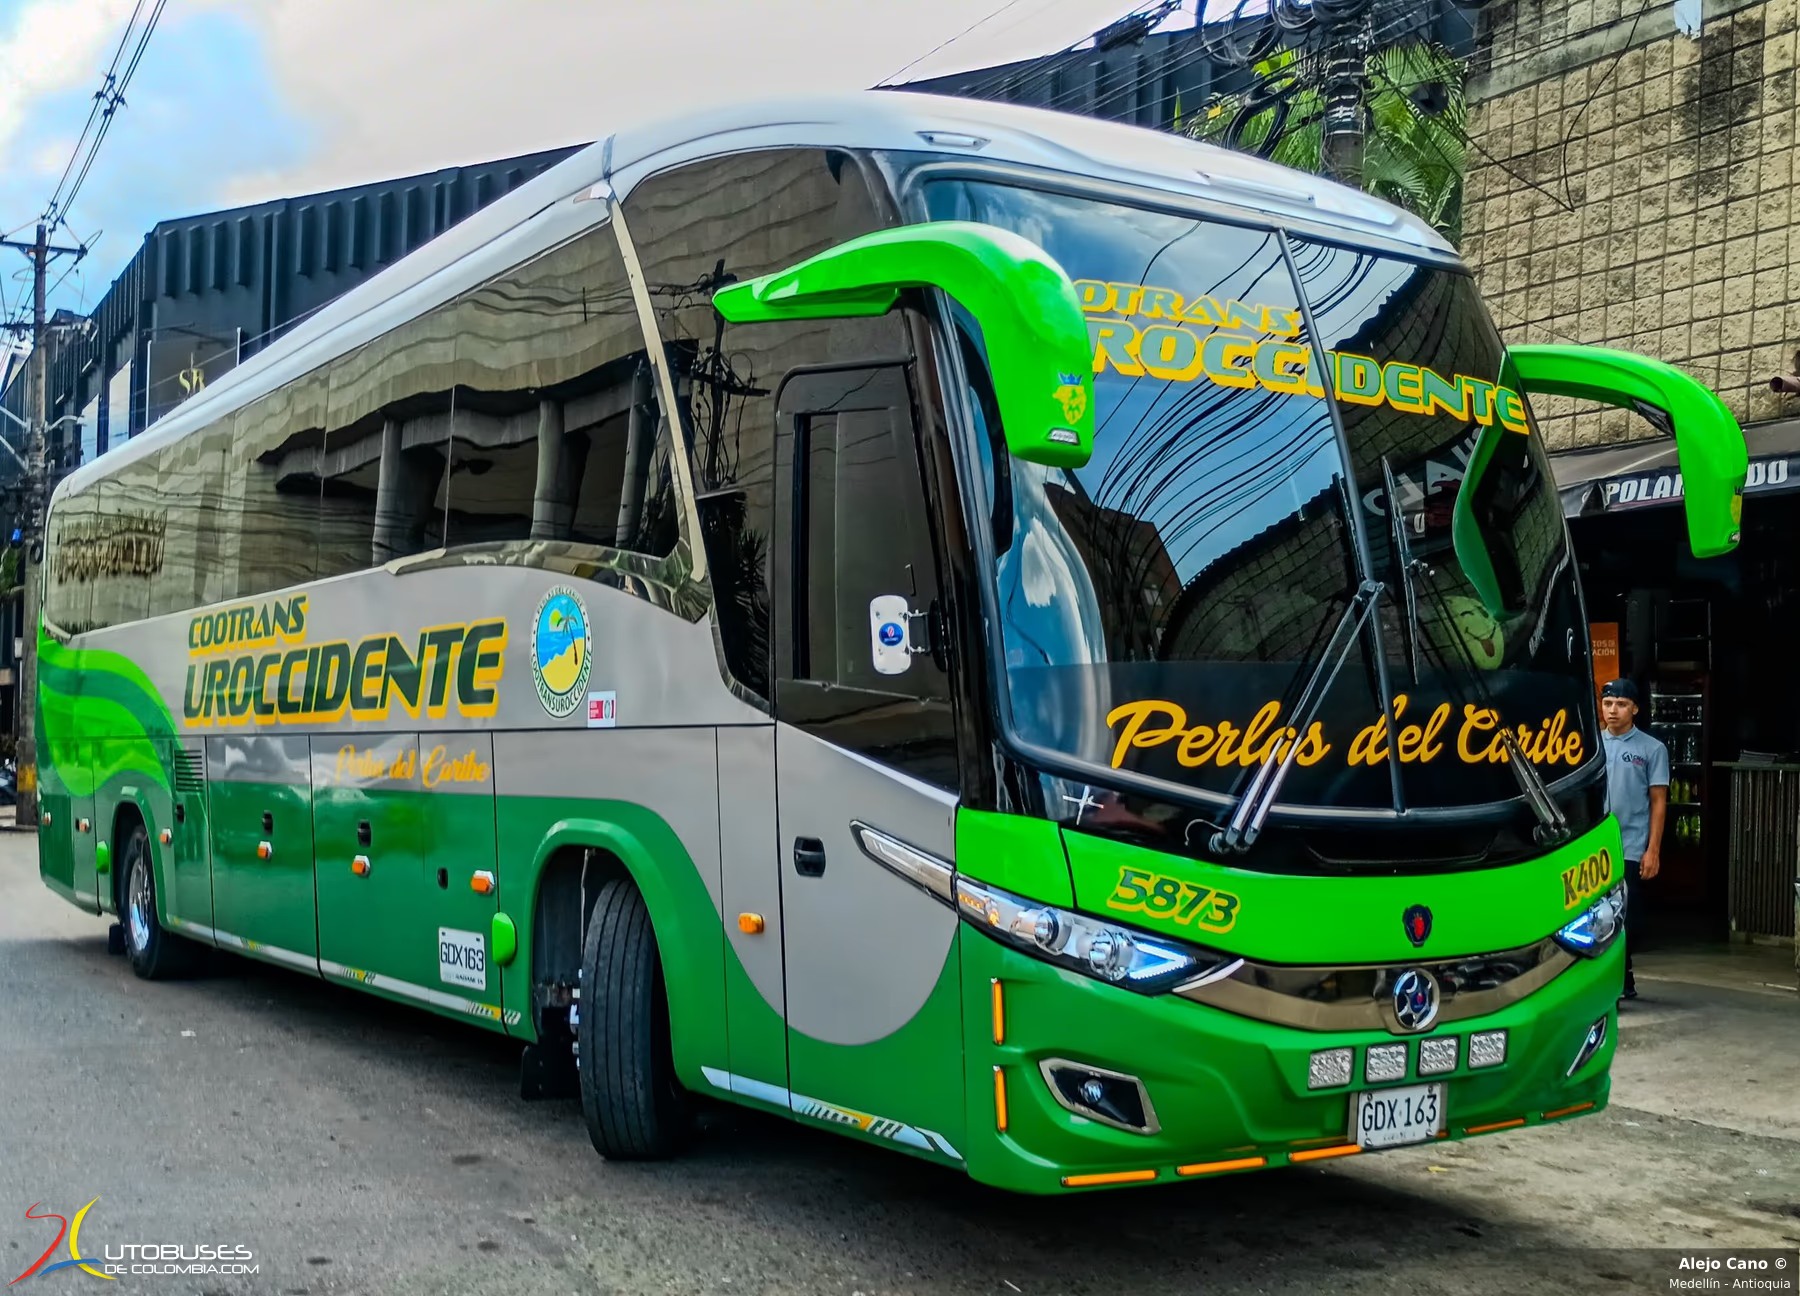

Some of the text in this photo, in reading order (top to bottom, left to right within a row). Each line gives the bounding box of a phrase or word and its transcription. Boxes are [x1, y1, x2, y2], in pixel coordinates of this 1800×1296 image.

[1073, 279, 1301, 337] OTRANS
[1085, 316, 1530, 436] ROCCIDENTE
[1606, 460, 1789, 504] POLADO
[187, 594, 310, 656] COOTRANS
[182, 617, 509, 728] UROCCIDENTE
[389, 749, 416, 780] del
[1106, 700, 1331, 769] Perlas
[1457, 702, 1584, 766] Caribe
[1107, 865, 1239, 935] 5873
[1561, 848, 1612, 910] K400
